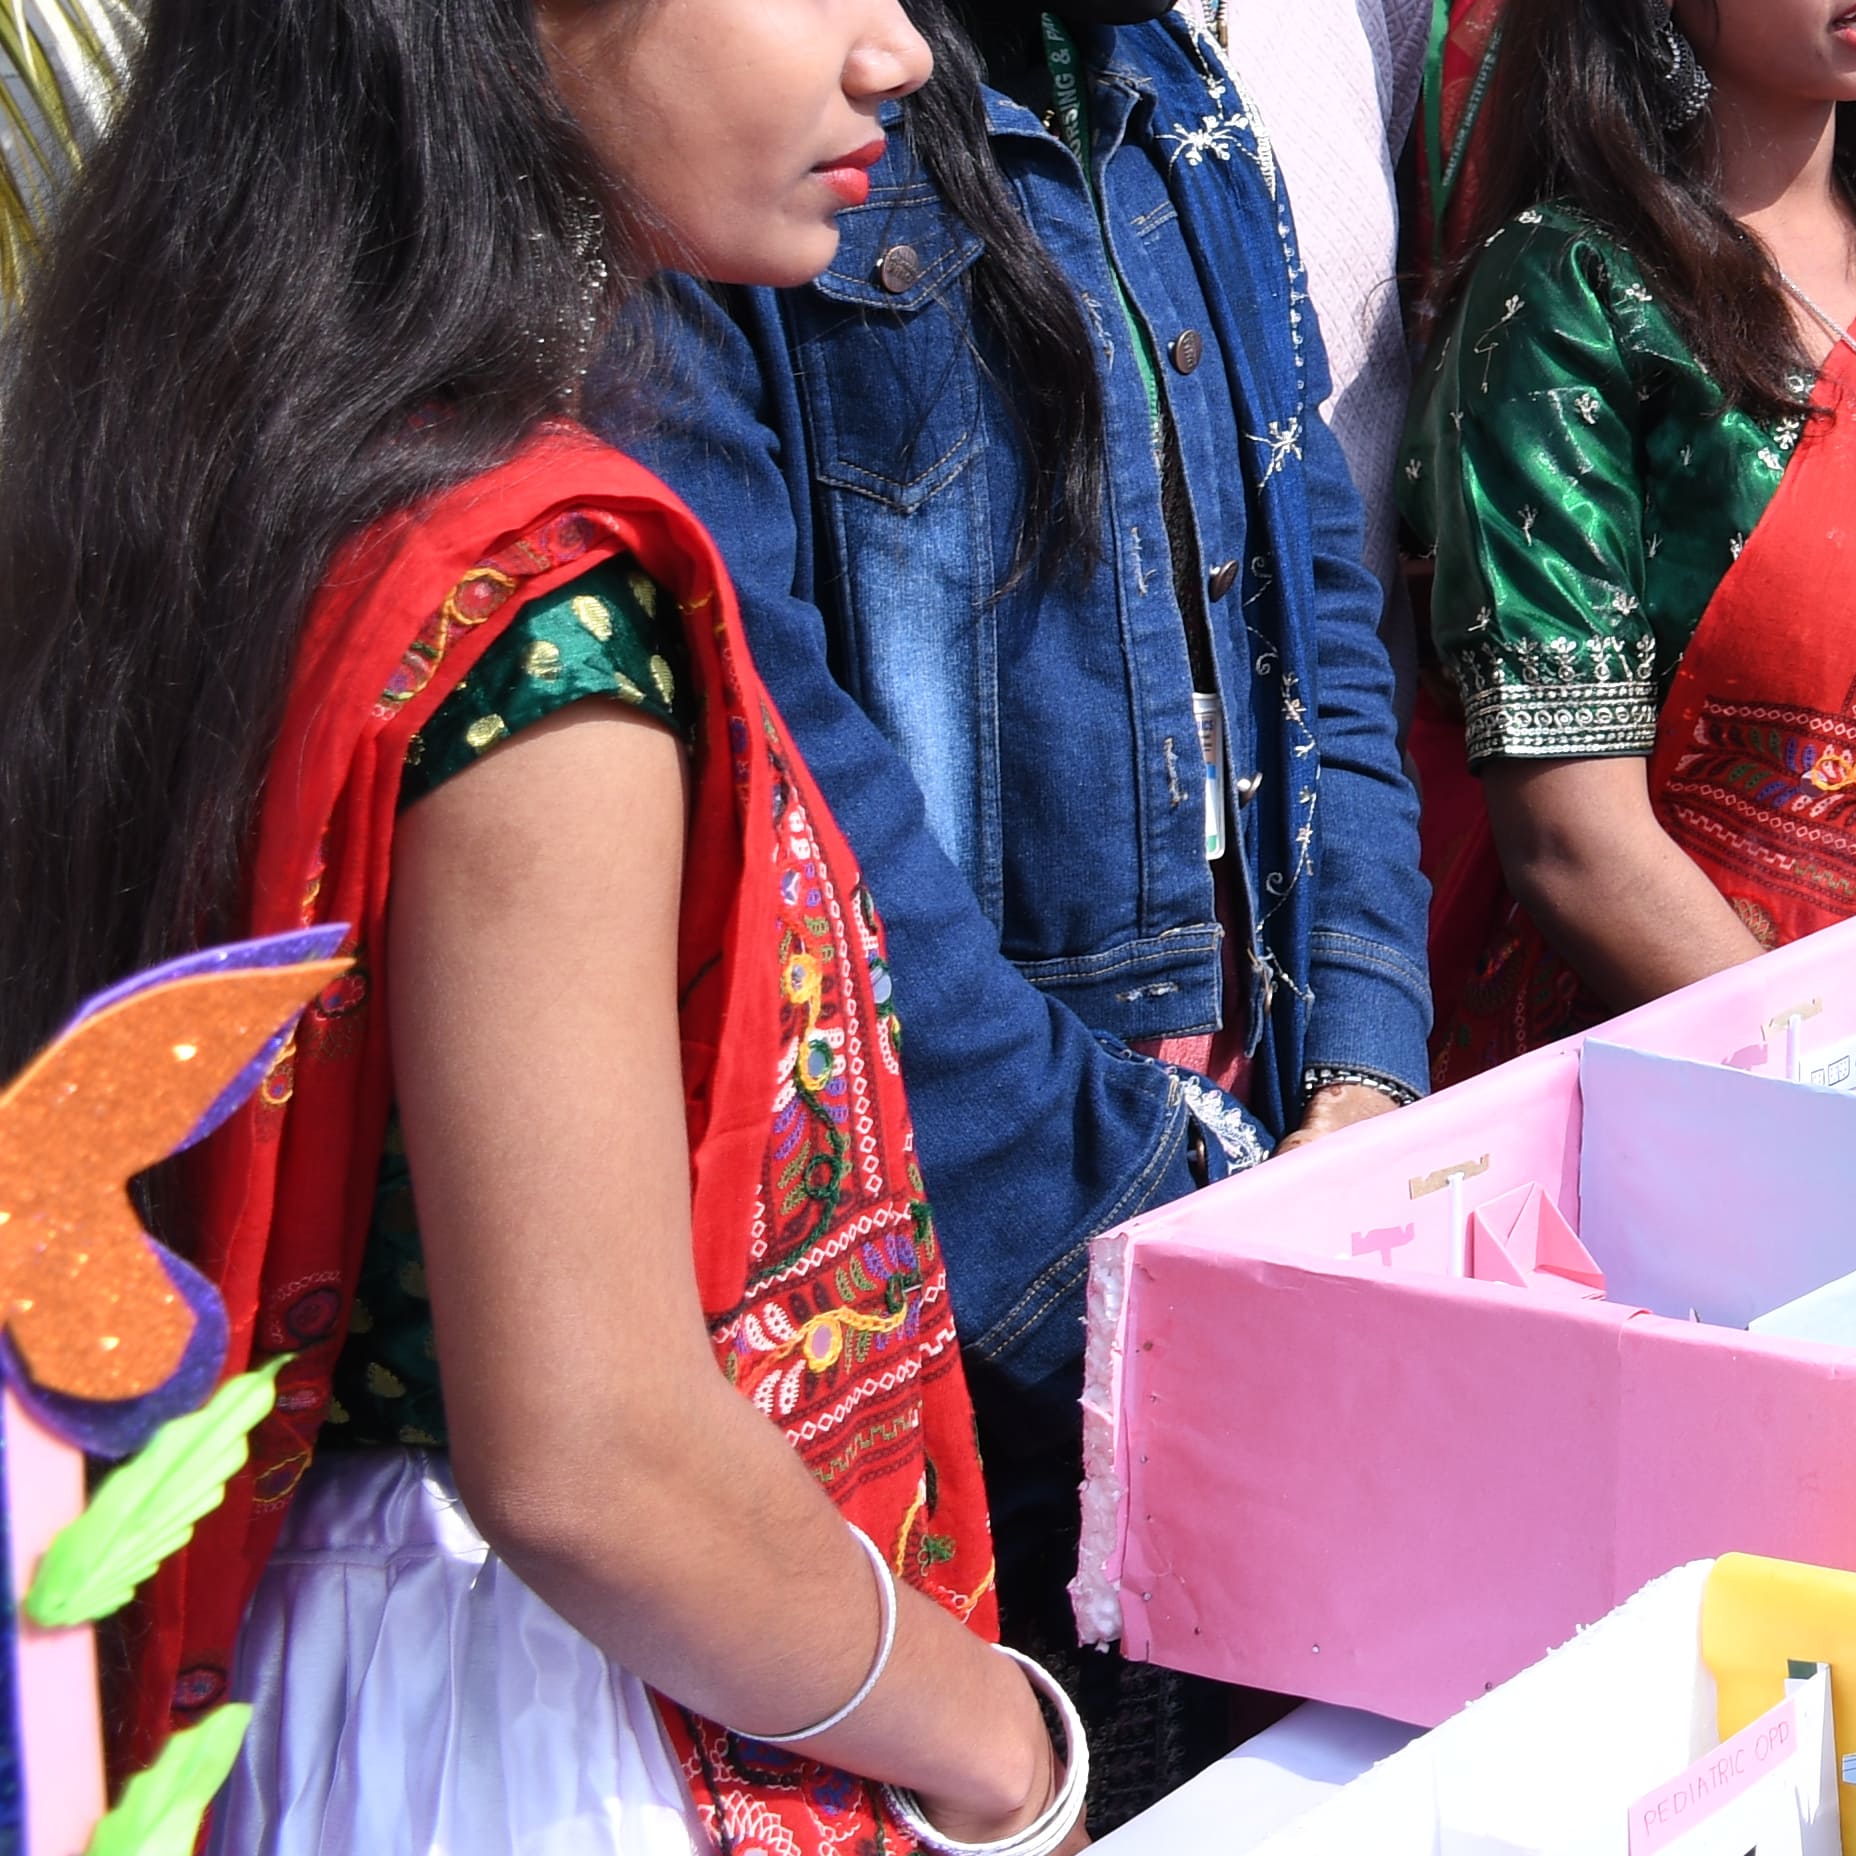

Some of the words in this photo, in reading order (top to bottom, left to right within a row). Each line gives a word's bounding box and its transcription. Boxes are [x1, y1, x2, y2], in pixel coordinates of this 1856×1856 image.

[1051, 48, 1071, 65] &
[1643, 1748, 1746, 1837] PEDIATRIC
[1754, 1720, 1790, 1762] OPD
